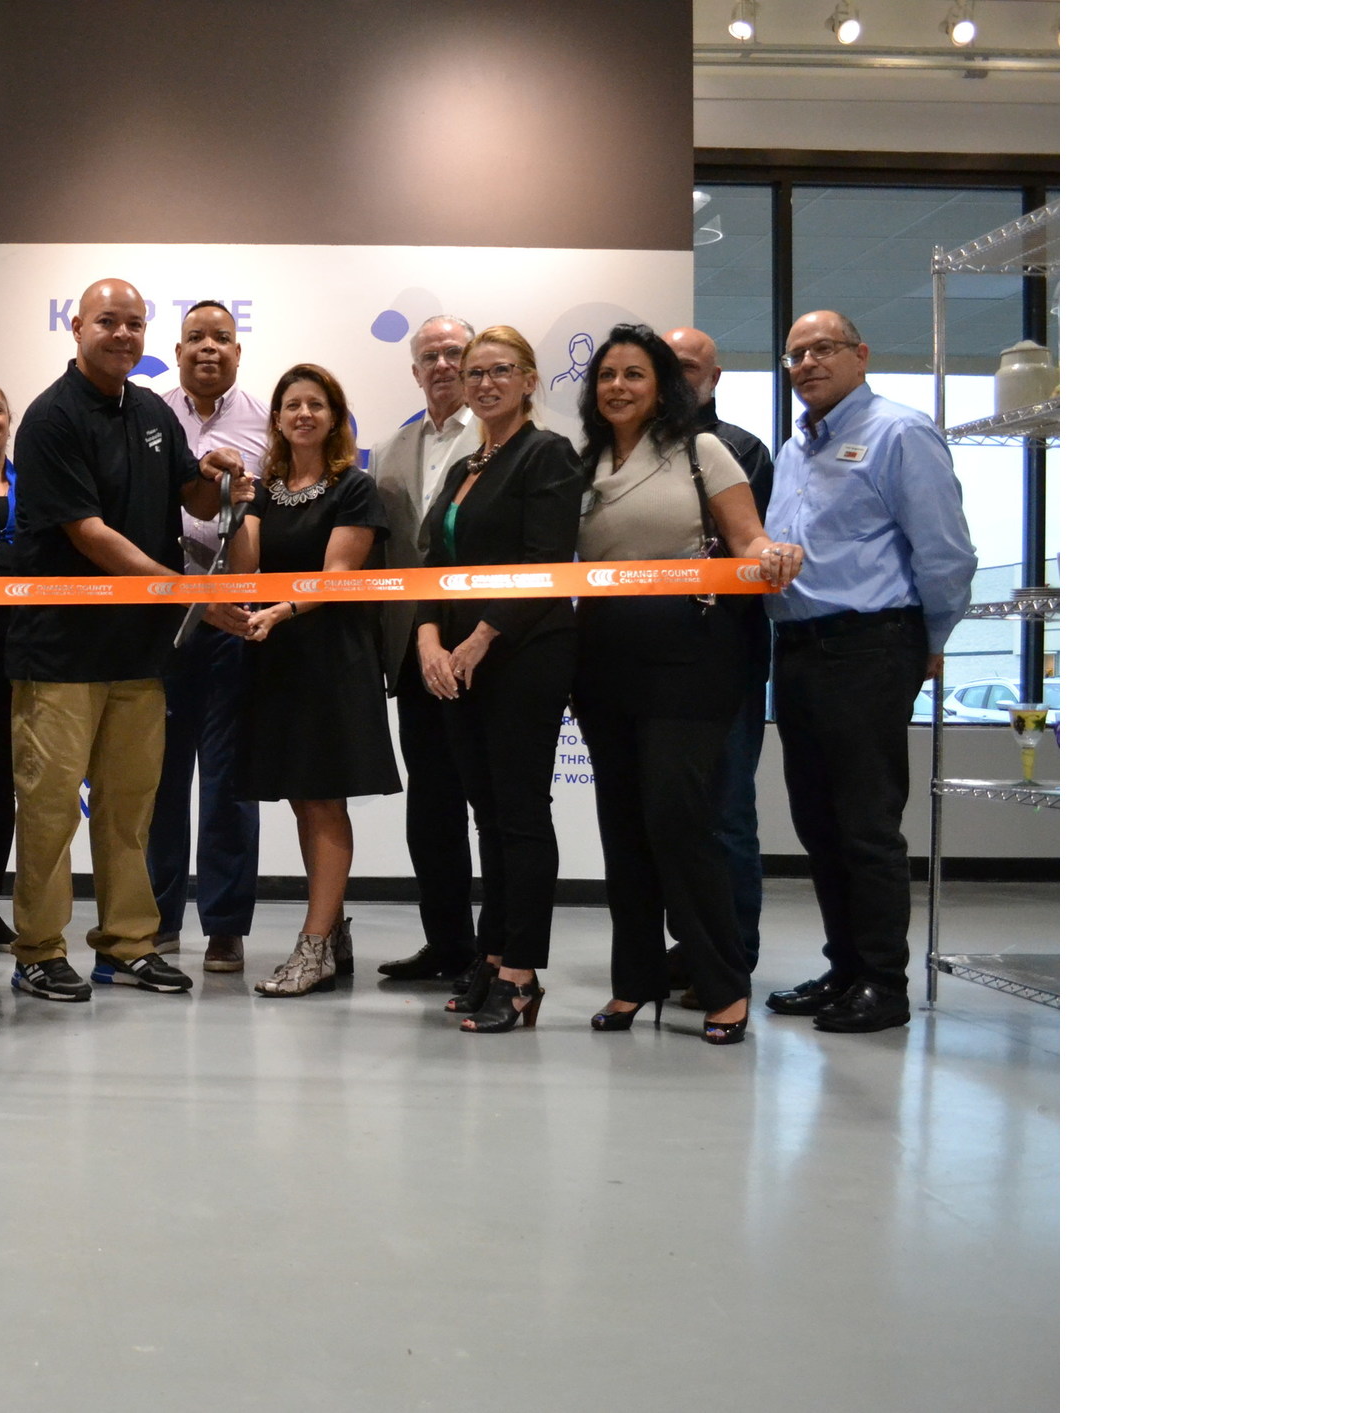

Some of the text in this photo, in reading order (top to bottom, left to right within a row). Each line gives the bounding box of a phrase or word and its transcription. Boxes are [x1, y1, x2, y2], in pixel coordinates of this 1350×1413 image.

[172, 300, 253, 333] TE
[619, 569, 699, 578] ORANGE COUNTY
[365, 578, 403, 586] COUNTY
[560, 735, 578, 745] TO
